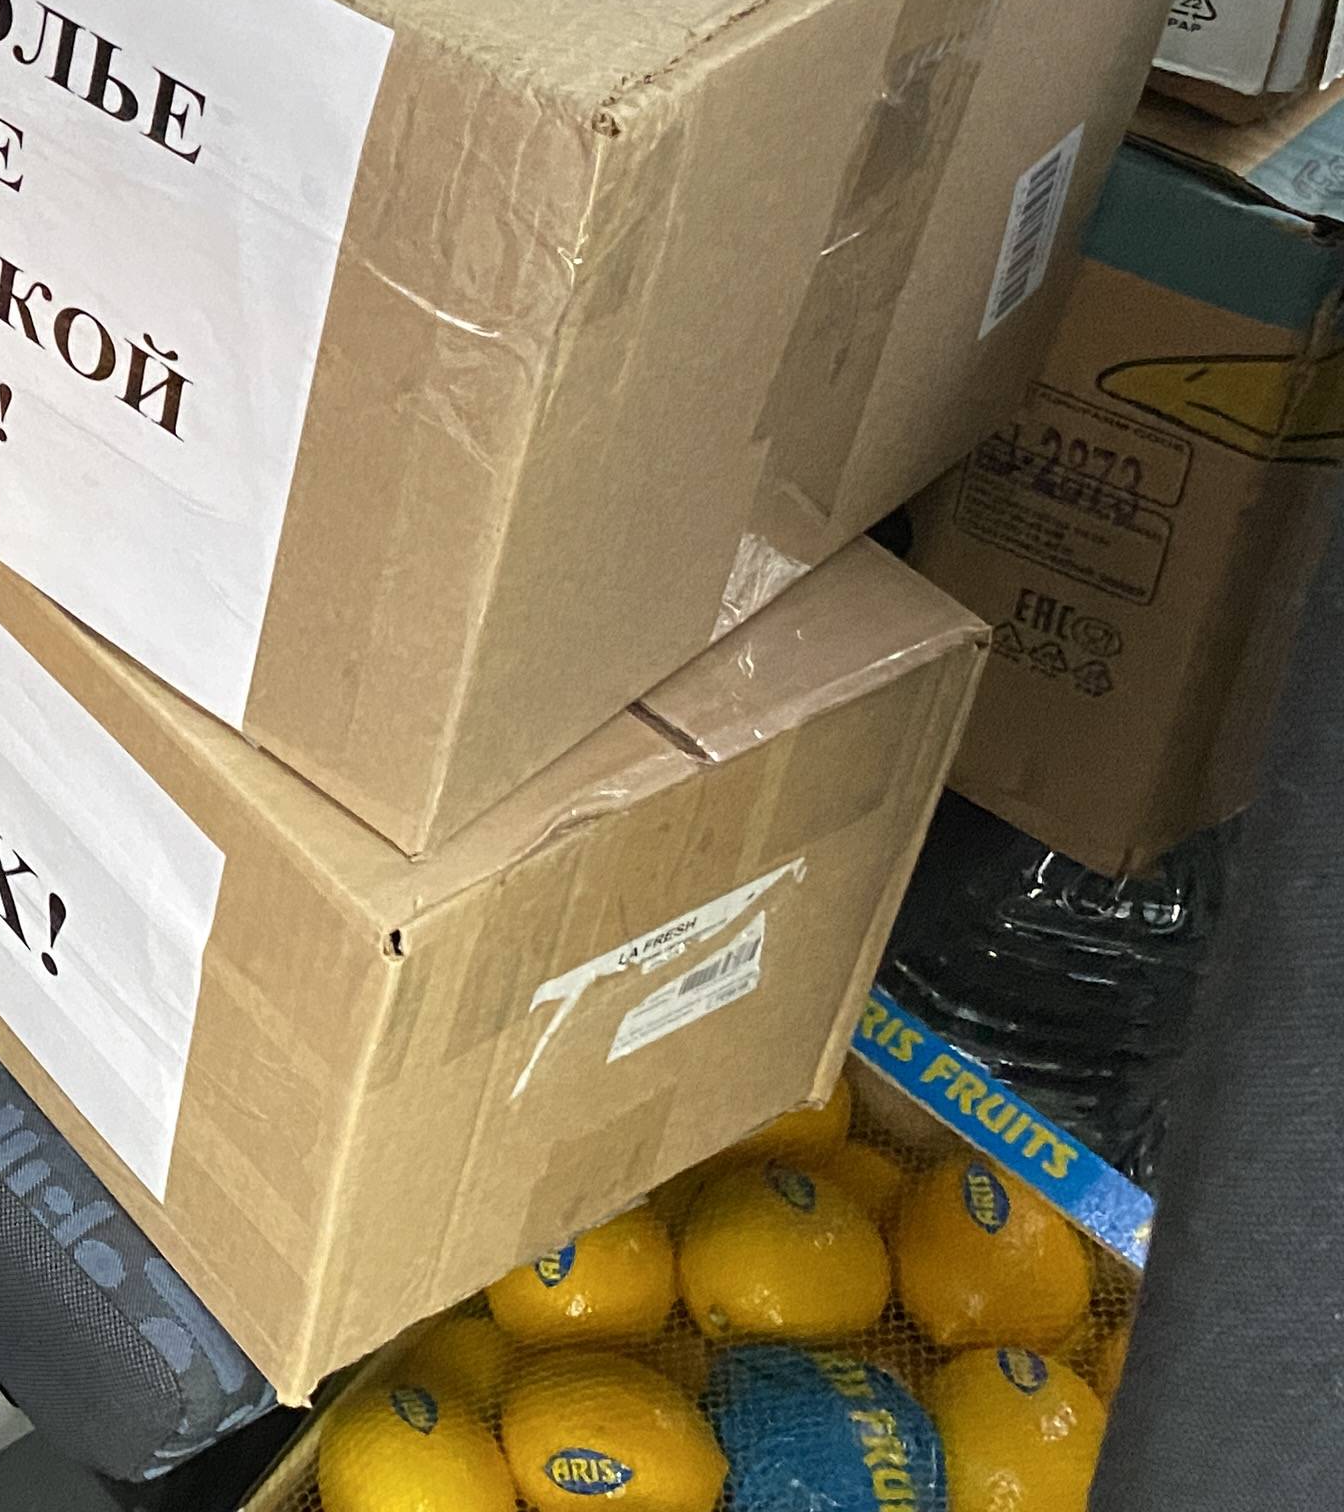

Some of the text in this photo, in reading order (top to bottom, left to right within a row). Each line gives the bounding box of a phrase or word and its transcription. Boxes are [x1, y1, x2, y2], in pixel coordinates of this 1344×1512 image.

[1167, 17, 1202, 33] PAP
[642, 915, 698, 953] FRESH
[859, 997, 1079, 1179] RIS FRUITS
[550, 1457, 616, 1486] ARIS
